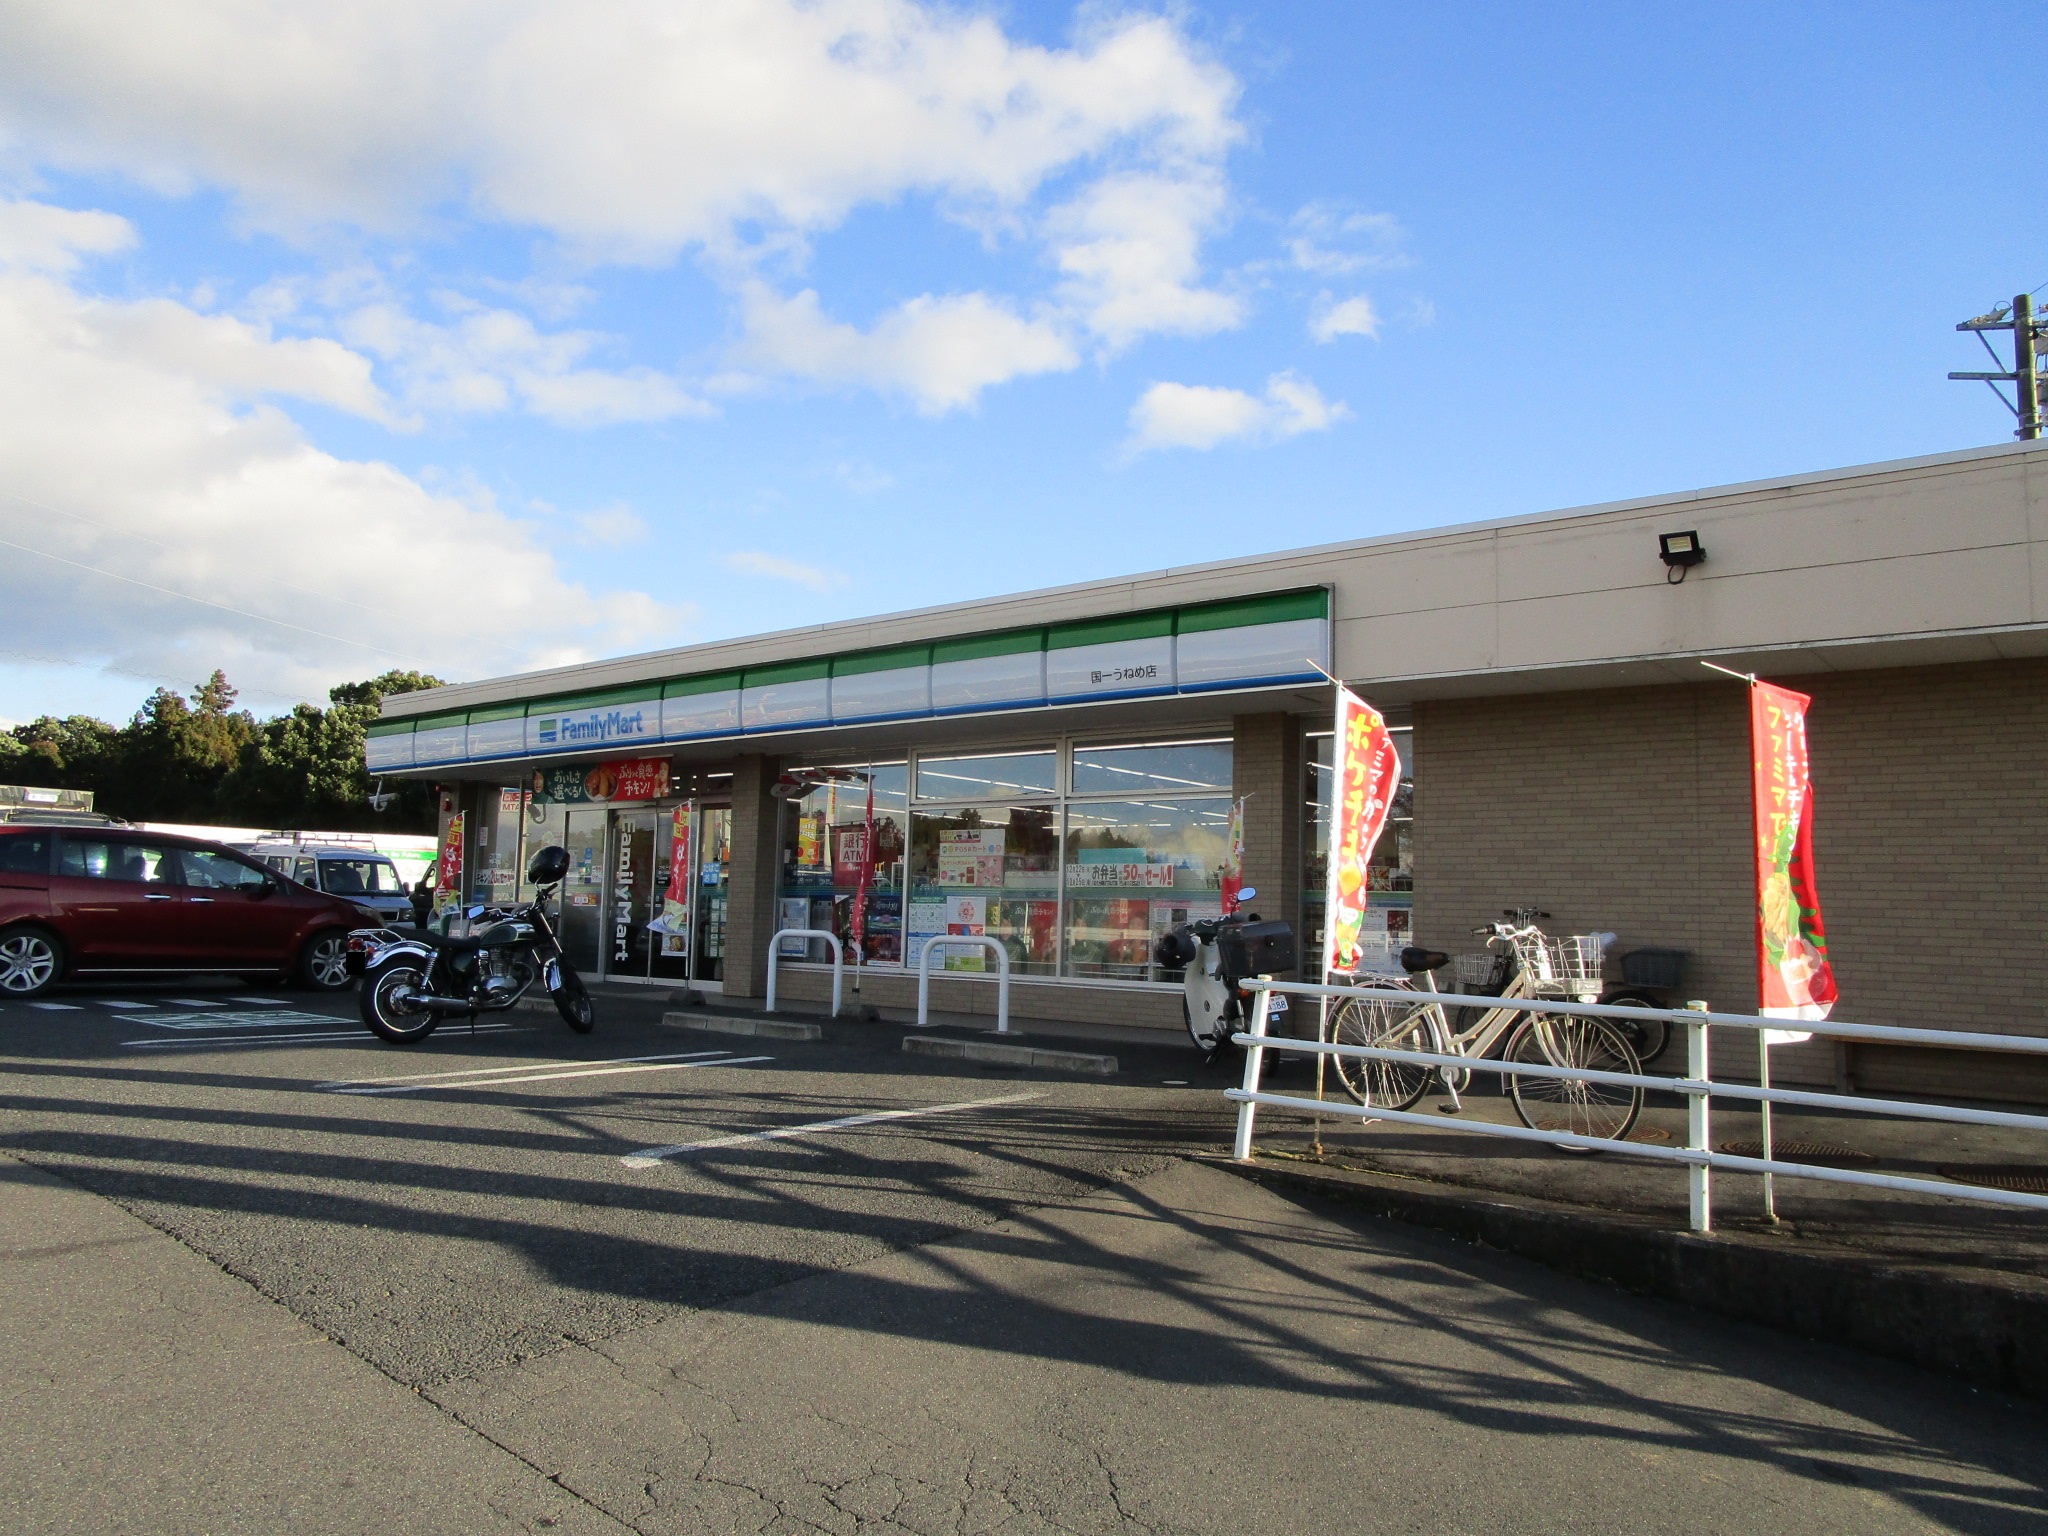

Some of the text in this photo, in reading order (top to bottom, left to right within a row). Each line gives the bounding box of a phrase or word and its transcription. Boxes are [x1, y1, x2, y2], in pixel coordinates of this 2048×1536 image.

[1091, 665, 1156, 683] 国一うねめ店
[561, 711, 643, 741] FamilyMart
[554, 770, 581, 784] おいしさ
[553, 786, 582, 800] 選べる!
[624, 782, 650, 796] チキン!
[1341, 713, 1380, 859] ポケチキ
[843, 850, 864, 861] ATM
[1092, 864, 1118, 881] お弁当
[615, 820, 636, 961] FamilyMart
